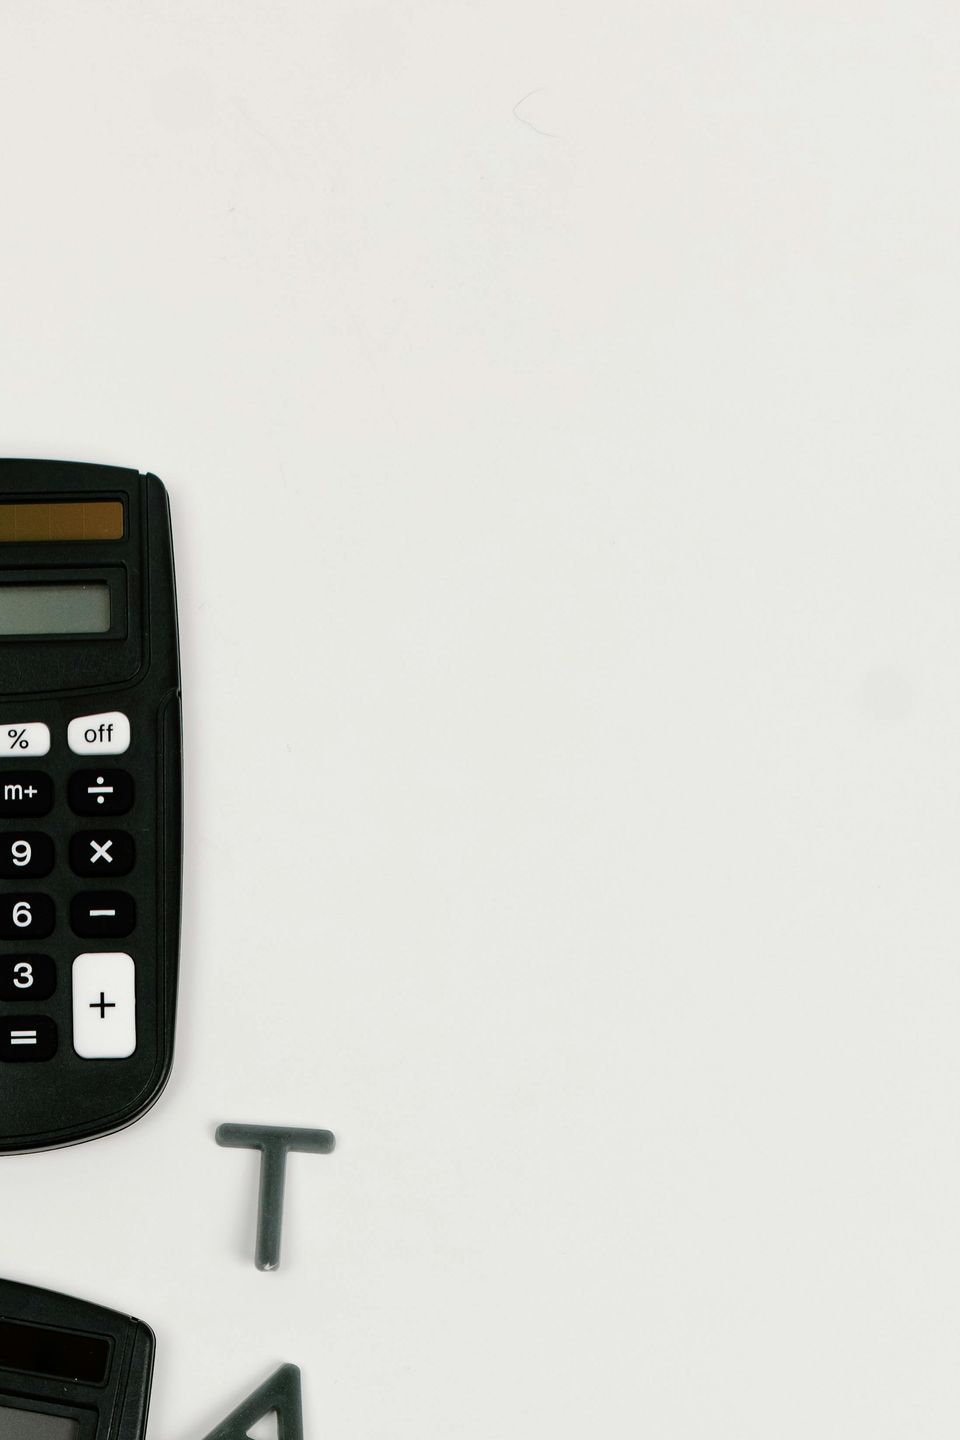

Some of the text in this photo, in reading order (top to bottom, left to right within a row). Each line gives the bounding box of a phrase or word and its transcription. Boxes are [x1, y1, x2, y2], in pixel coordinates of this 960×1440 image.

[83, 723, 114, 744] off
[4, 784, 38, 801] m+
[11, 840, 32, 867] 9
[12, 901, 33, 928] 6
[13, 962, 34, 989] 3
